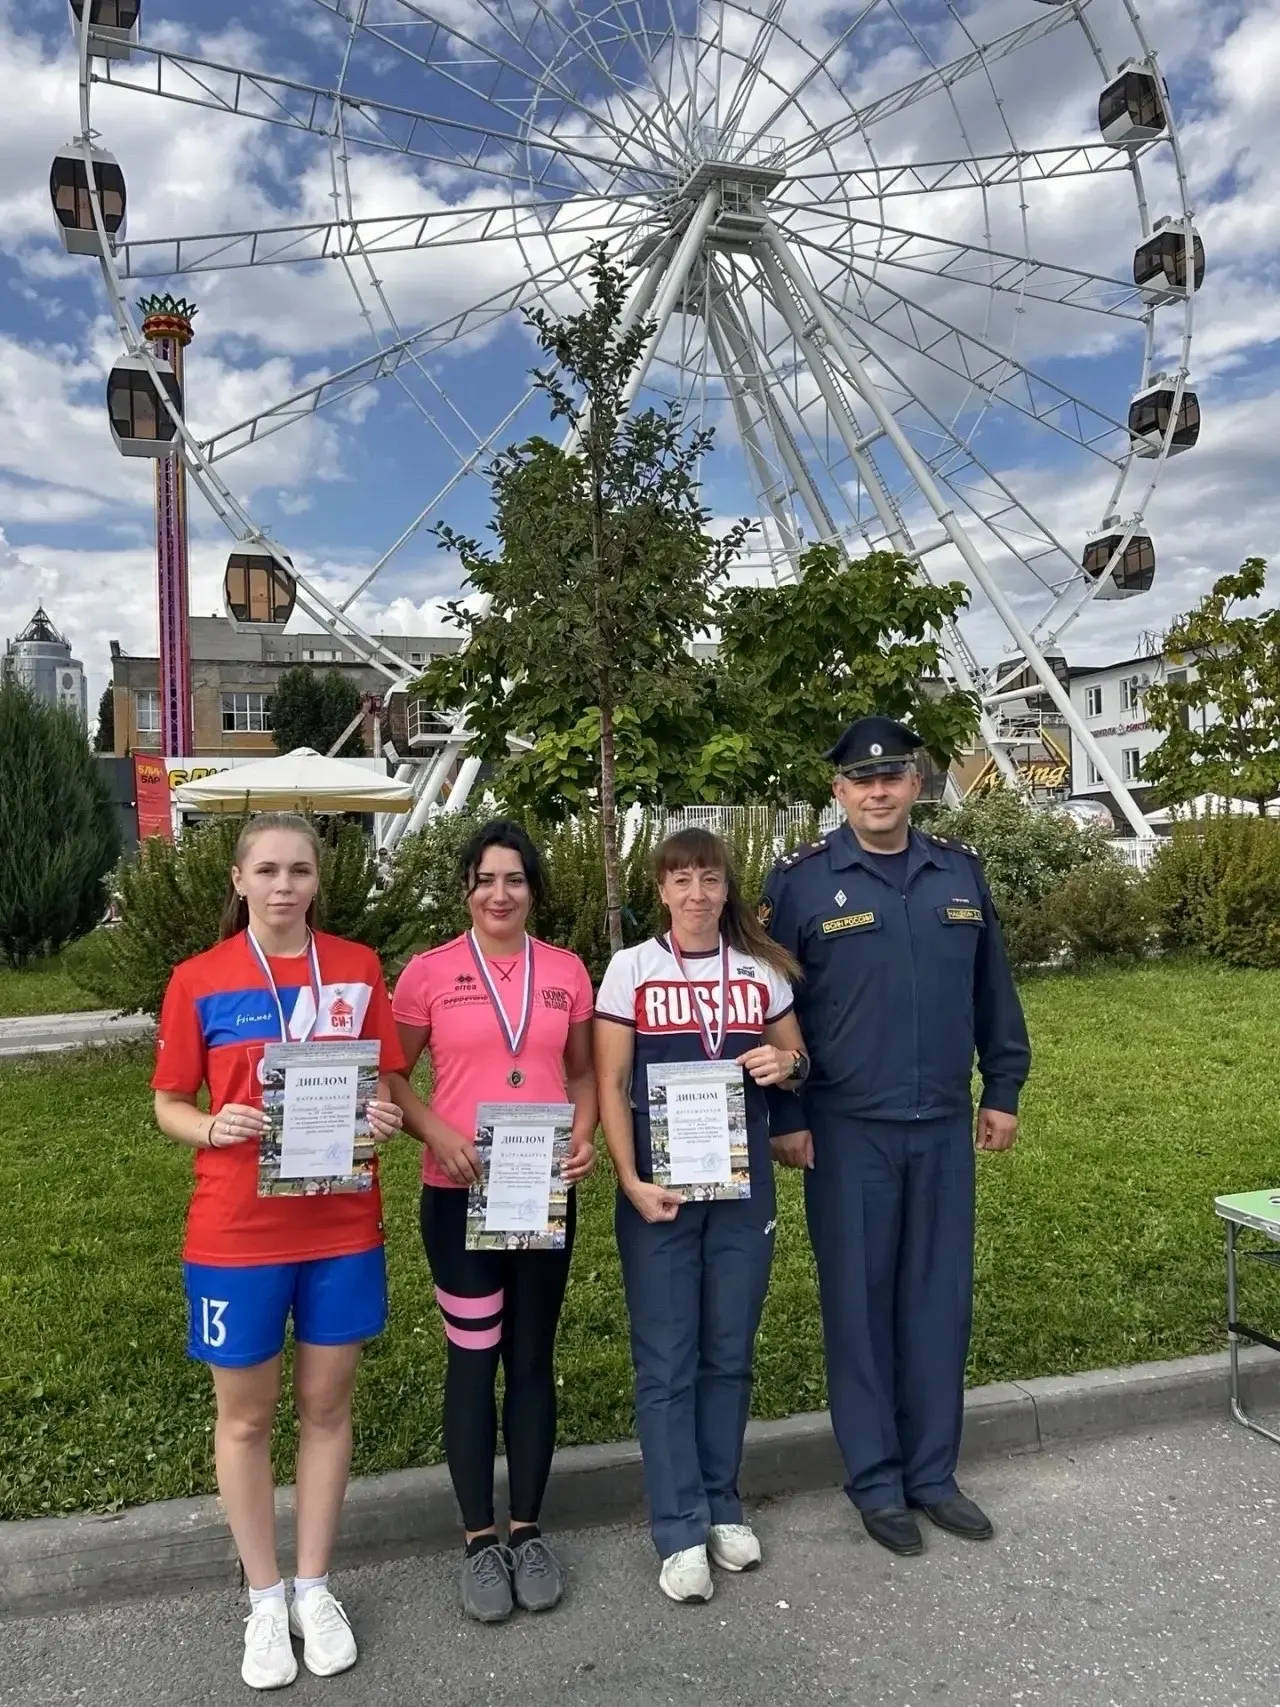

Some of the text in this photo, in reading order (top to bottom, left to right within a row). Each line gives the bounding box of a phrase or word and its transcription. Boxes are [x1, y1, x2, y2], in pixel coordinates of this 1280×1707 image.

[141, 775, 160, 784] БАР
[645, 984, 763, 1027] RUSSIA
[331, 1016, 353, 1028] СИ-1
[296, 1076, 348, 1087] ДИПЛОМ
[675, 1092, 718, 1102] ДИПЛОМ
[501, 1136, 545, 1144] ДИПЛОМ
[201, 1296, 230, 1347] 13
